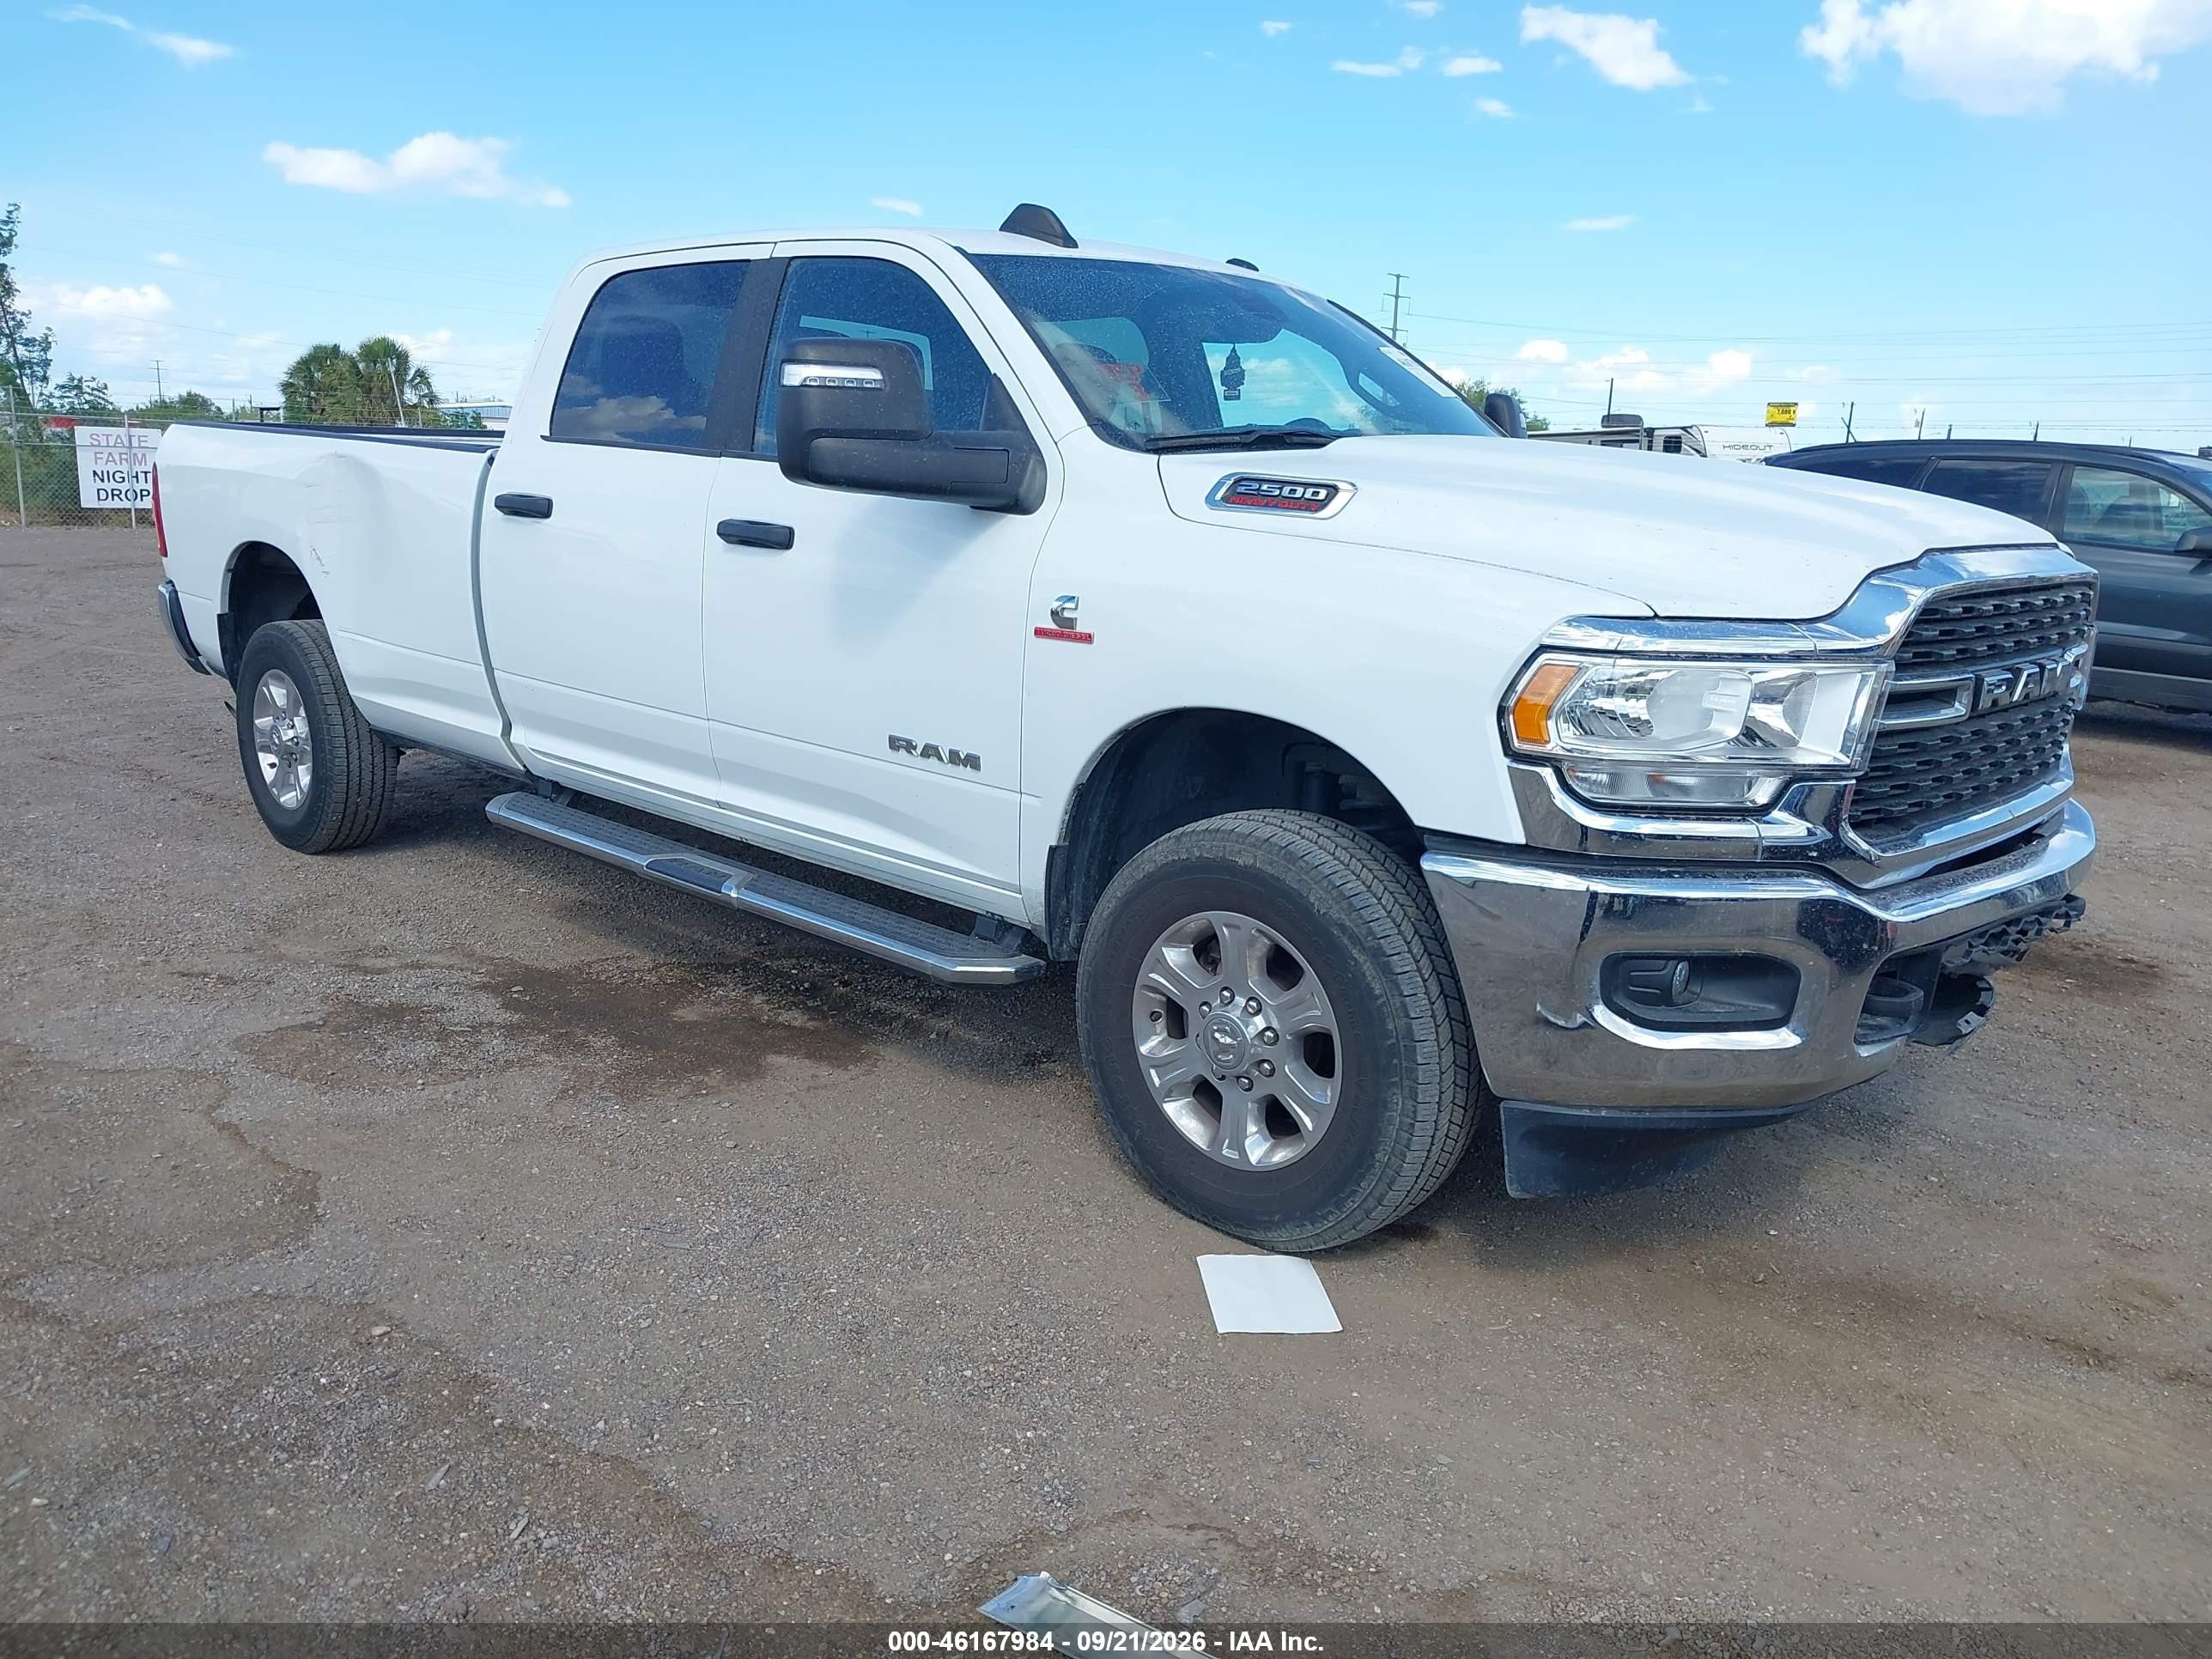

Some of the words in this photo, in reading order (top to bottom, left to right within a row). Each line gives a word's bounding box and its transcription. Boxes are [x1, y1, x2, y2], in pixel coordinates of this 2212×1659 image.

[89, 433, 149, 447] STATE
[94, 452, 148, 466] FARM
[92, 470, 151, 484] NIGHT
[96, 488, 151, 502] DROP
[1236, 482, 1328, 501] 2500
[1978, 659, 2071, 710] RAM
[888, 734, 981, 771] RAM
